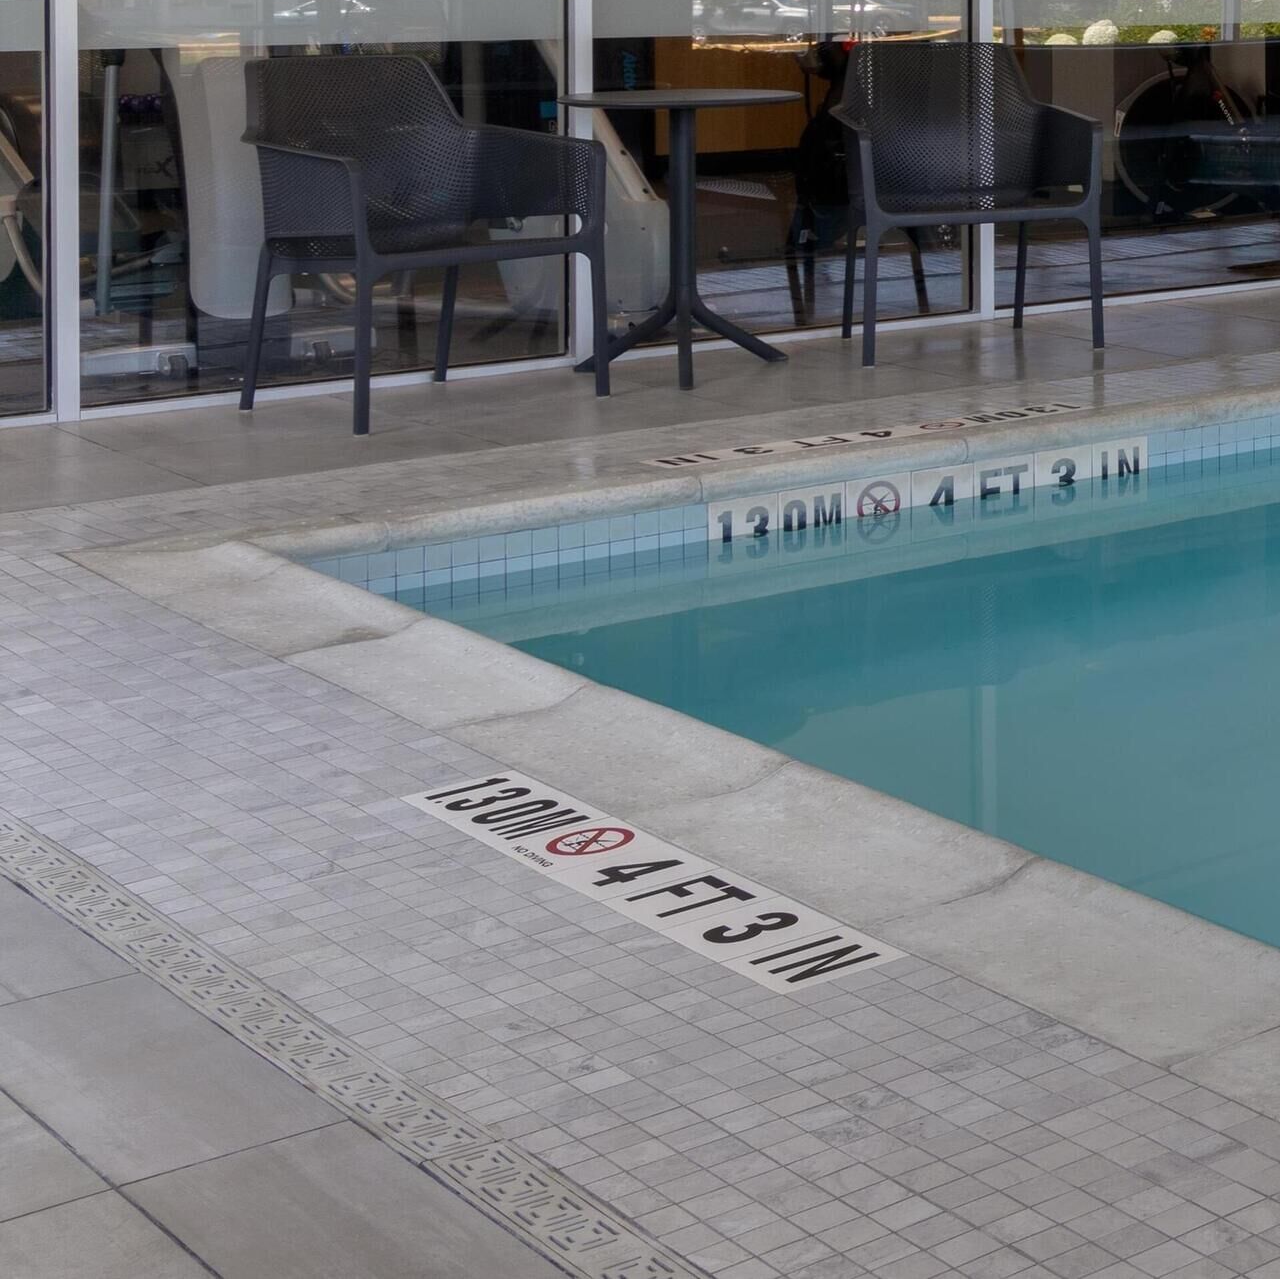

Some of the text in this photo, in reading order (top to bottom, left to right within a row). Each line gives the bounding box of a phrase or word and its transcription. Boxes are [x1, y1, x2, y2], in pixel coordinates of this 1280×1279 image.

[793, 436, 852, 448] FT
[860, 430, 892, 438] 4
[656, 453, 720, 466] IN
[732, 446, 774, 455] 3
[980, 464, 1028, 500] FT
[1051, 458, 1076, 487] 3
[1101, 446, 1140, 480] IN
[512, 845, 554, 868] NO DIVING
[592, 859, 684, 886] 4
[624, 875, 757, 918] FT
[702, 912, 799, 944] 3
[748, 935, 881, 983] IN
